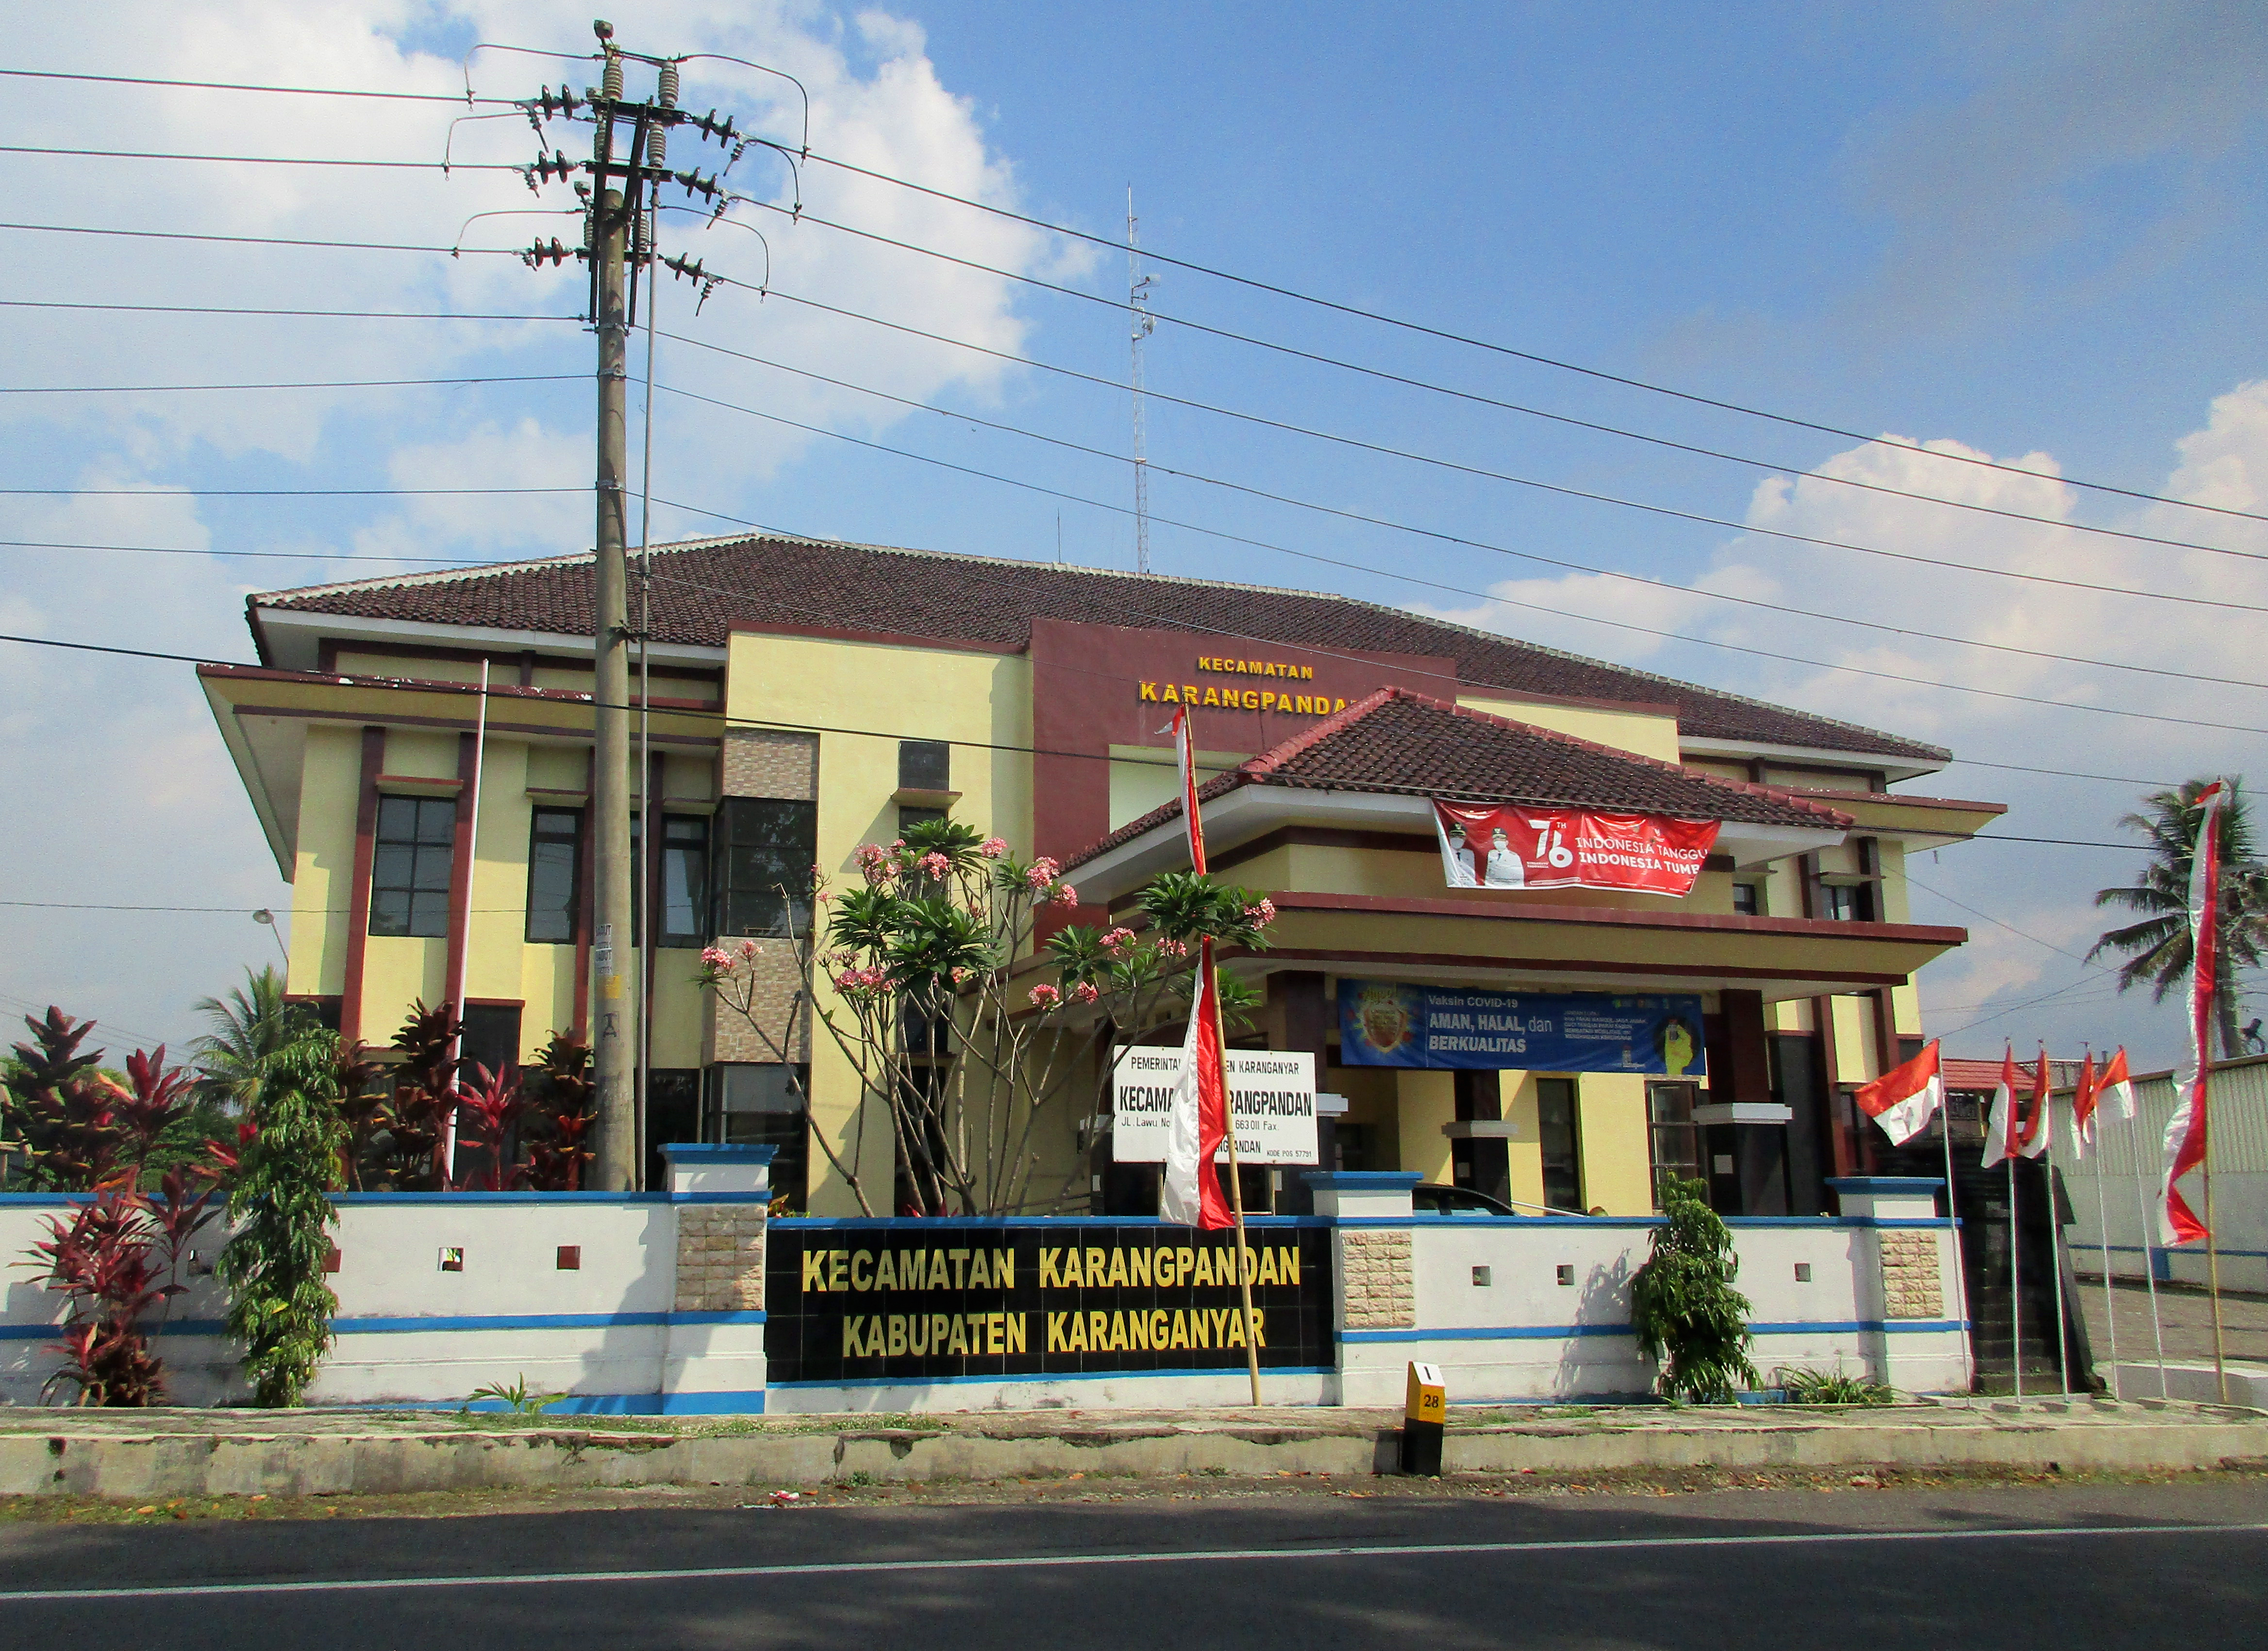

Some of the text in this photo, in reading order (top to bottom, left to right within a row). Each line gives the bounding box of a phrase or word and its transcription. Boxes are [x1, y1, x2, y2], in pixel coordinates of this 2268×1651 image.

[1199, 657, 1313, 679] KECAMATAN
[1139, 681, 1357, 715] KARANGPANDA
[1528, 819, 1573, 868] 76
[1575, 837, 1708, 860] INDONESIA TANGGU
[1578, 852, 1700, 875] INDONESIA TUMB
[1428, 994, 1518, 1008] Vaksin COVID-19
[1430, 1012, 1474, 1032] AMAN,
[1478, 1014, 1525, 1035] HALAL,
[1529, 1016, 1552, 1032] dan
[1429, 1035, 1526, 1053] BERKUALITAS
[1131, 1057, 1181, 1071] PEMERINTA
[1239, 1060, 1300, 1075] KARANGANYAR
[1119, 1085, 1312, 1117] KECAMA RANGPANDAN
[1136, 1117, 1158, 1127] Lawu
[802, 1246, 1300, 1292] KECAMATAN KARANGPANDAN
[843, 1308, 1266, 1357] KABUPATEN KARANGANYAR
[1423, 1393, 1439, 1408] 28
